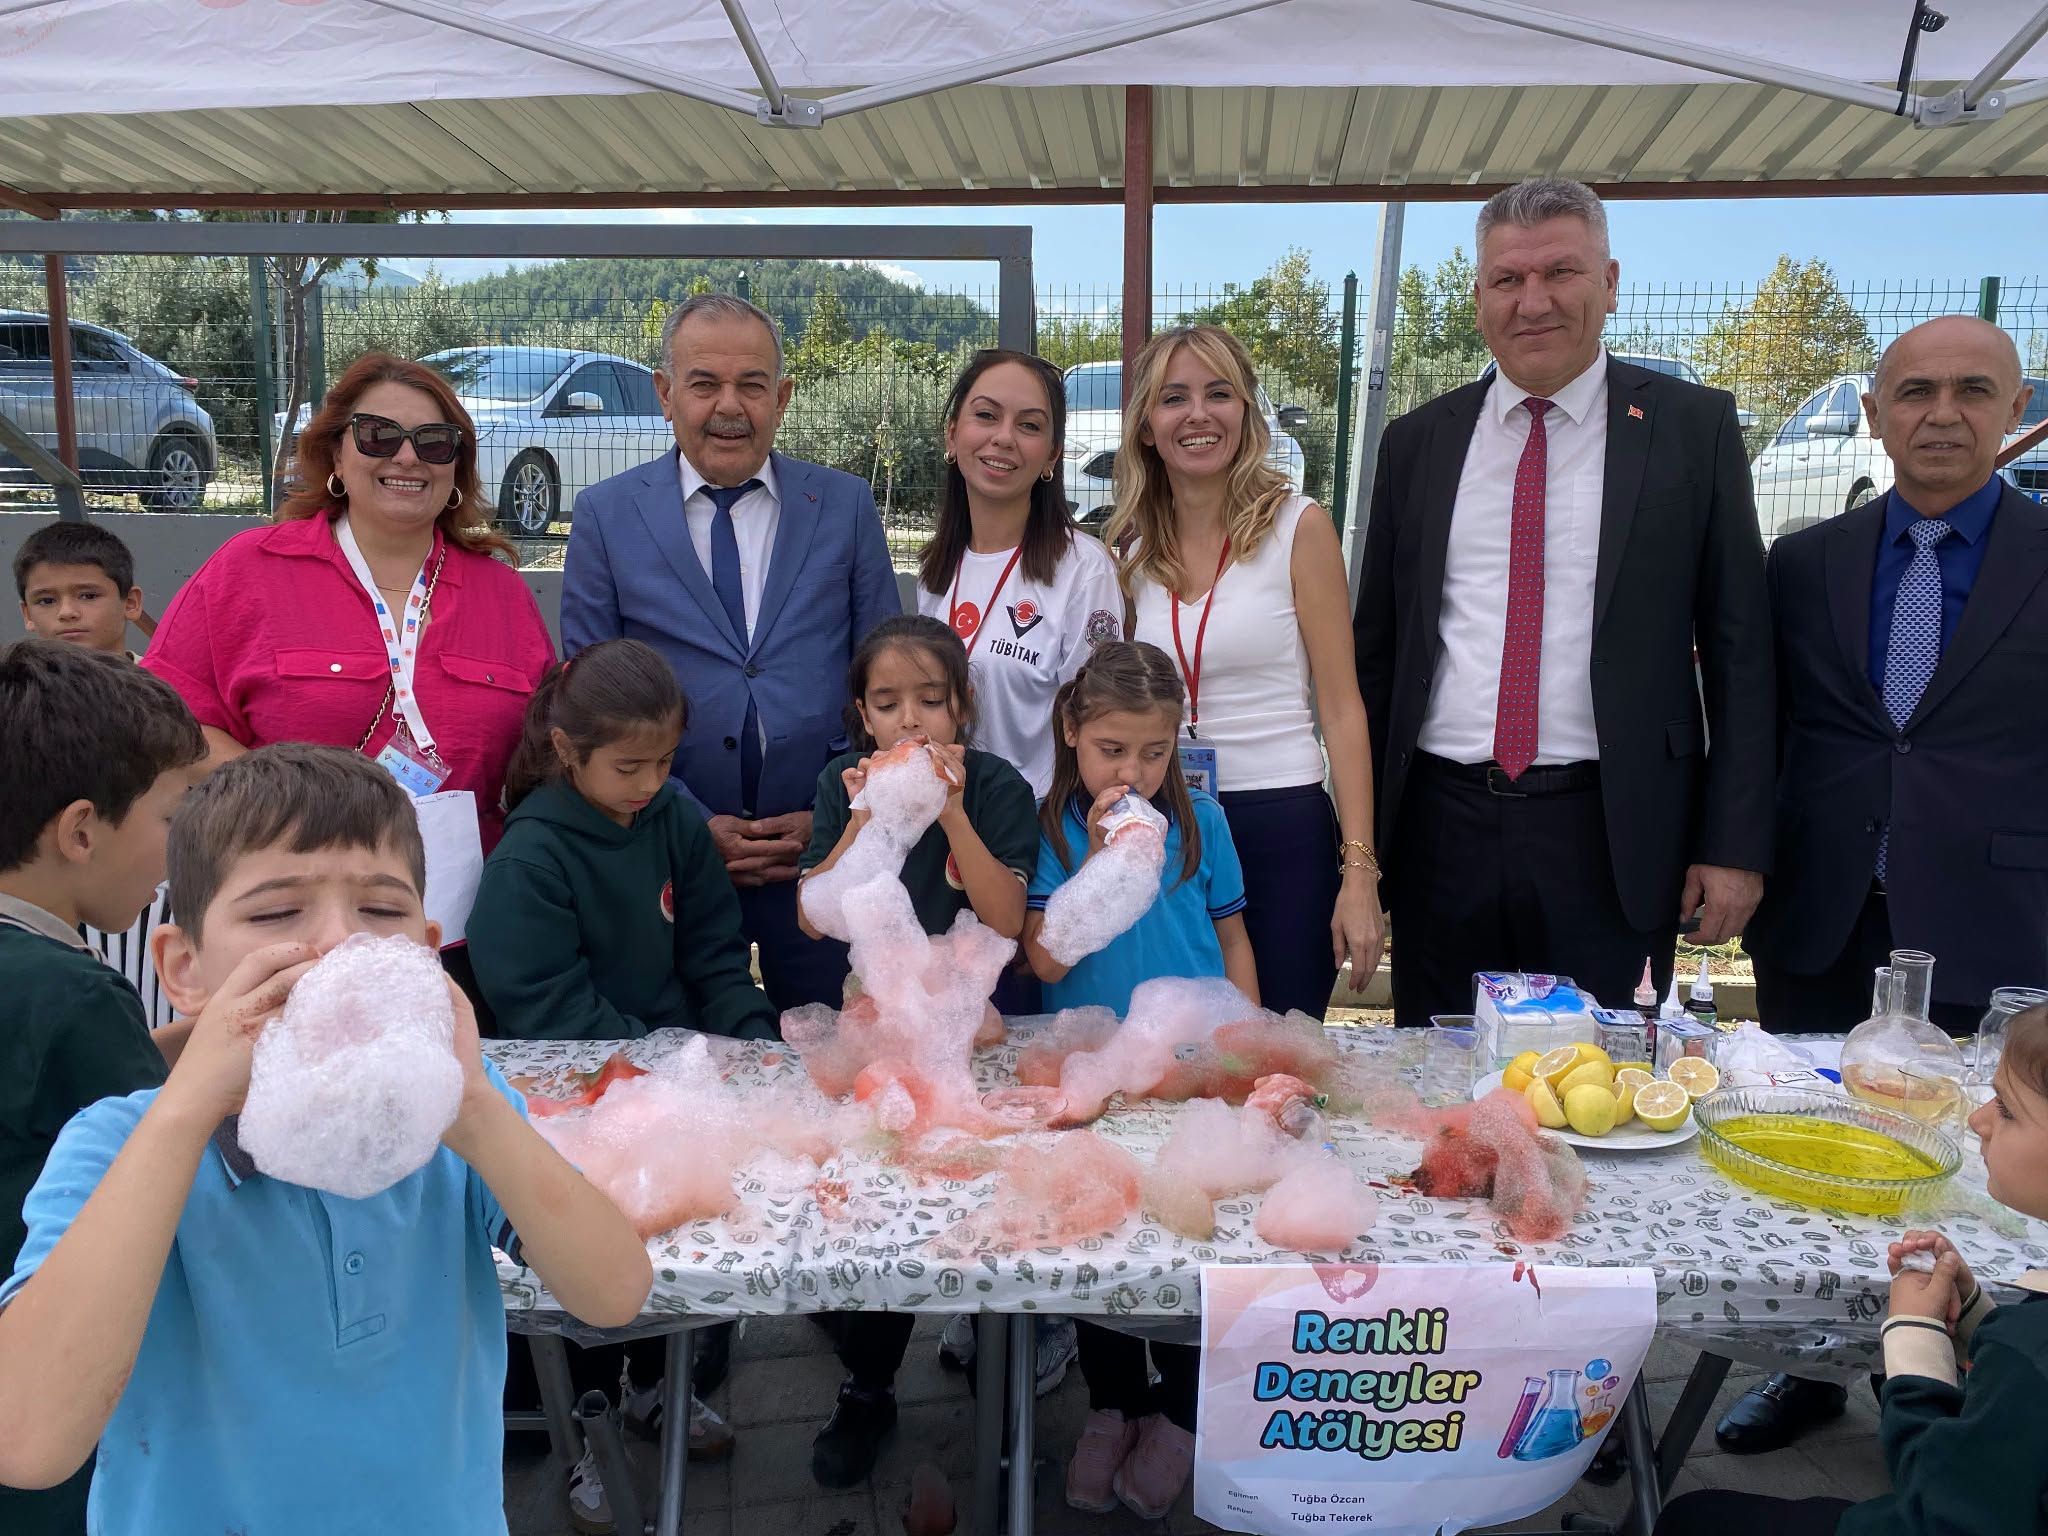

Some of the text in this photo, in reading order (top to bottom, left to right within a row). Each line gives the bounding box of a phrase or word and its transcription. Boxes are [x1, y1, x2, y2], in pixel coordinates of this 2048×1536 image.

[989, 638, 1040, 666] TÜBİTAK
[1293, 1308, 1449, 1355] Renkli
[1254, 1362, 1482, 1411] Deneyler
[1260, 1409, 1465, 1461] Atölyesi
[1291, 1512, 1373, 1522] Tuğba Tekerek
[1292, 1493, 1365, 1504] Tuğba Özcan
